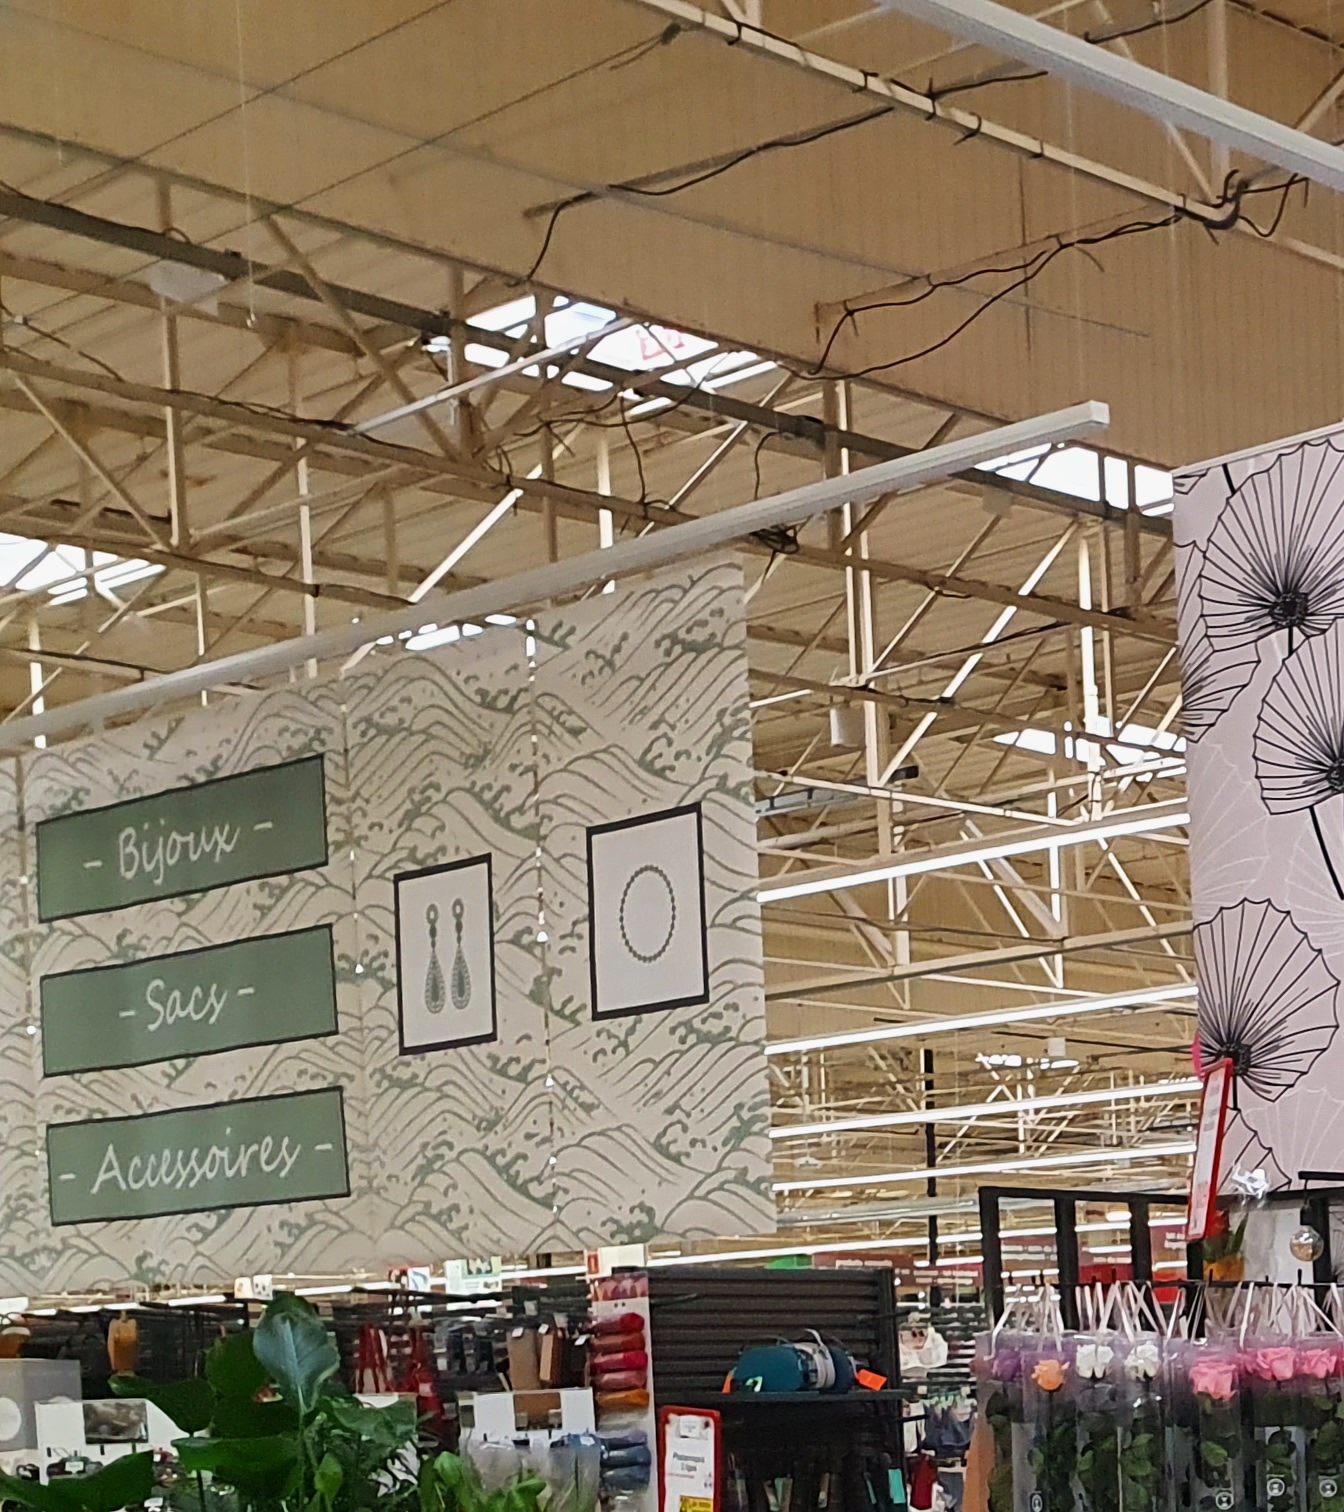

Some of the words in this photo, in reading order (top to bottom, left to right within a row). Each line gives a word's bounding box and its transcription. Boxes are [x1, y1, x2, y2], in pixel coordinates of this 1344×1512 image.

[117, 815, 241, 886] Bijoux
[145, 978, 228, 1033] Sacs
[89, 1127, 301, 1195] Accessoires
